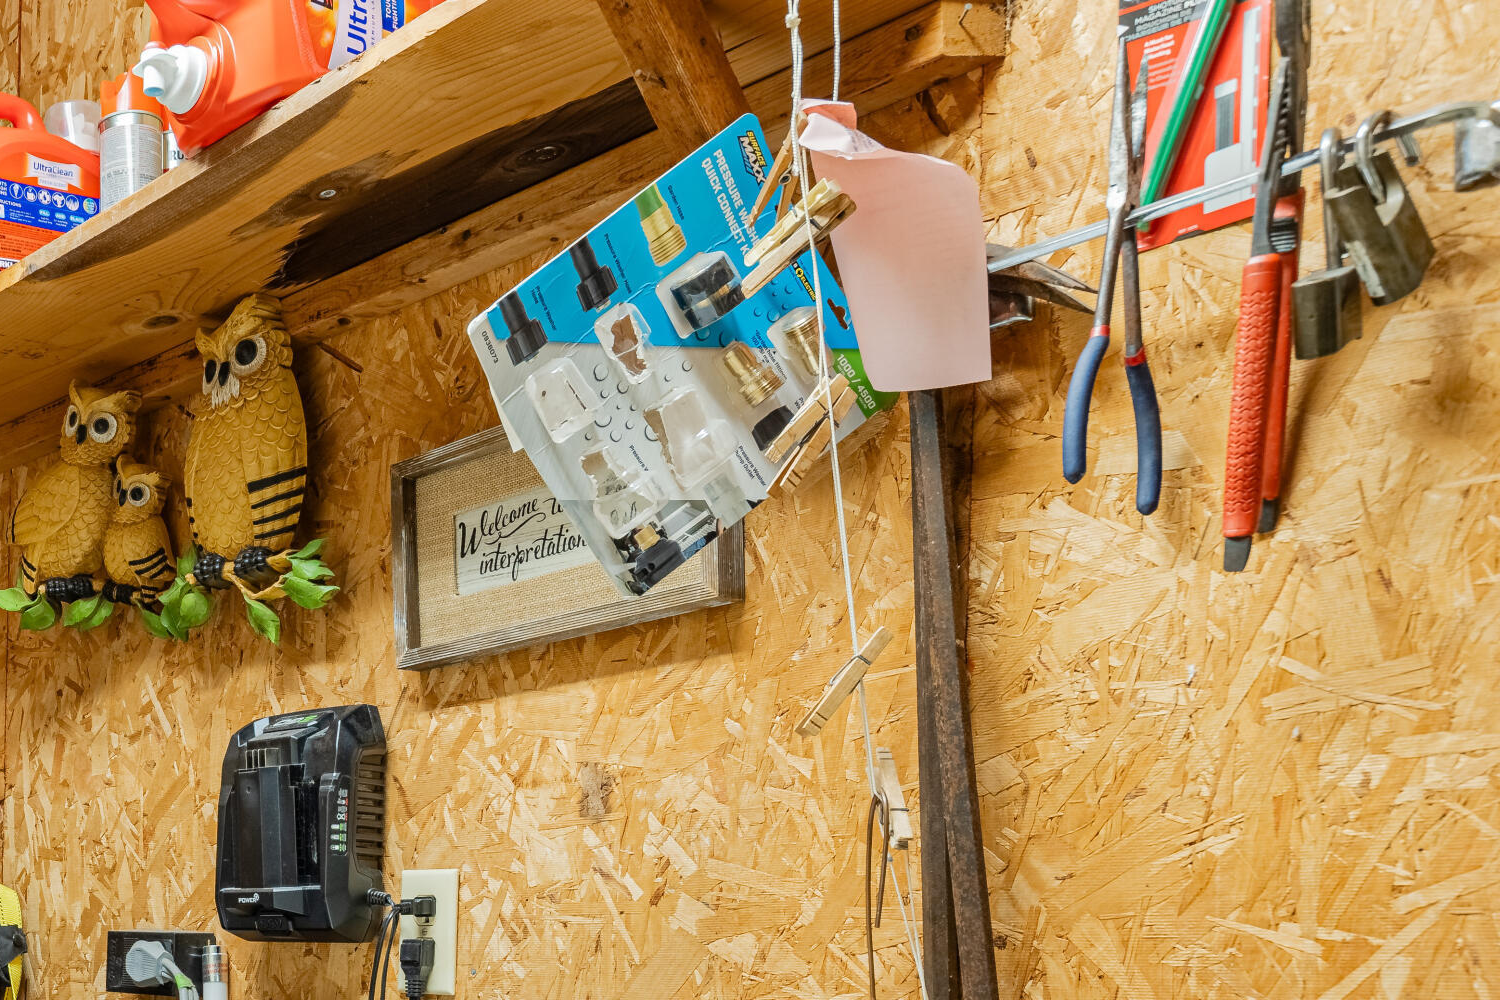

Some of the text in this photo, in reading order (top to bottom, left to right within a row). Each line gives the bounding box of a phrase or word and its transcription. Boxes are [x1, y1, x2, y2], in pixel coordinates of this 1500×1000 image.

[33, 162, 74, 177] UltraClean
[739, 136, 766, 184] MAXX
[747, 131, 767, 167] SURFACE
[700, 158, 721, 194] QUICK
[716, 190, 747, 249] CONNECT
[713, 149, 744, 210] PRESSURE
[837, 354, 877, 410] 1000 4500
[629, 444, 645, 469] Pressure
[738, 445, 767, 487] Pressure Washer
[458, 498, 541, 559] Welcome
[479, 522, 587, 582] interpretation
